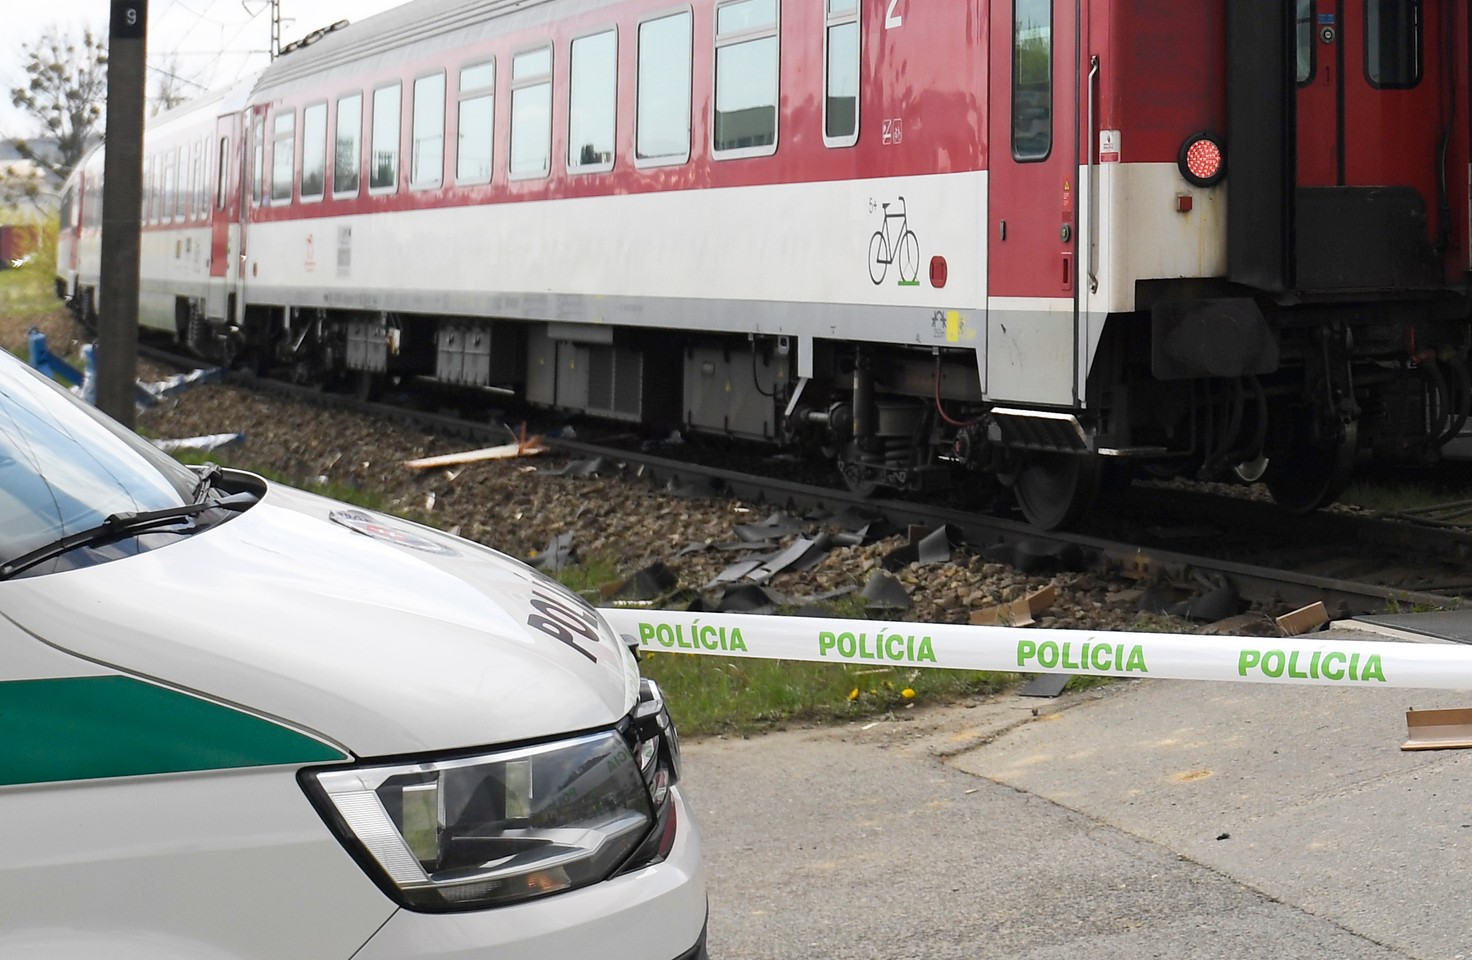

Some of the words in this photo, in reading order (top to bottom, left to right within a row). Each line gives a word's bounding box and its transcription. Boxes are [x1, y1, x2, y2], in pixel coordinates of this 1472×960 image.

[127, 8, 137, 25] 9
[638, 619, 748, 652] POLÍCIA
[818, 627, 938, 663] POLÍCIA
[1016, 636, 1149, 673] POLÍCIA
[1238, 644, 1387, 683] POLÍCIA
